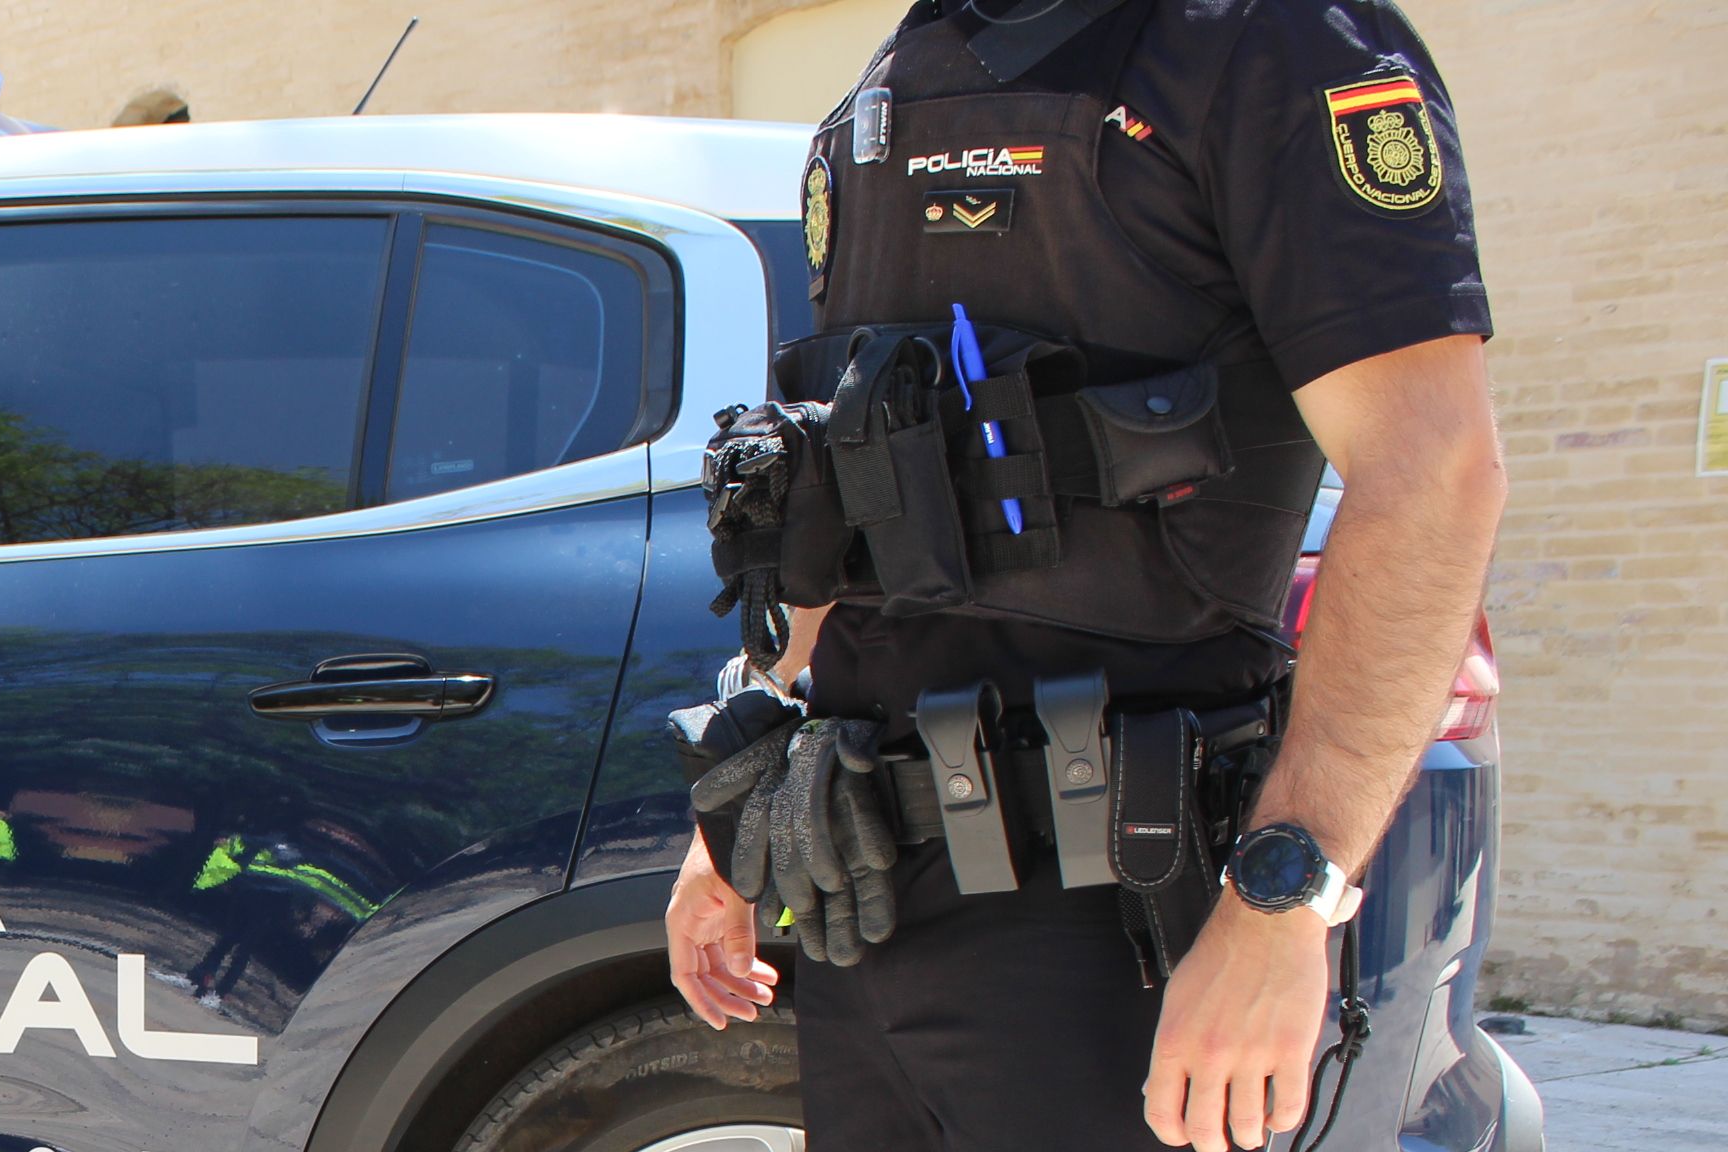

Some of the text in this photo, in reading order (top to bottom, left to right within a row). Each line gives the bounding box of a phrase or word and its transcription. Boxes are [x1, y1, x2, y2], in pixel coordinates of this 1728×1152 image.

[966, 163, 1042, 178] NACIONAL
[1336, 123, 1365, 185] CUERPO
[1362, 183, 1431, 204] NACIONAL
